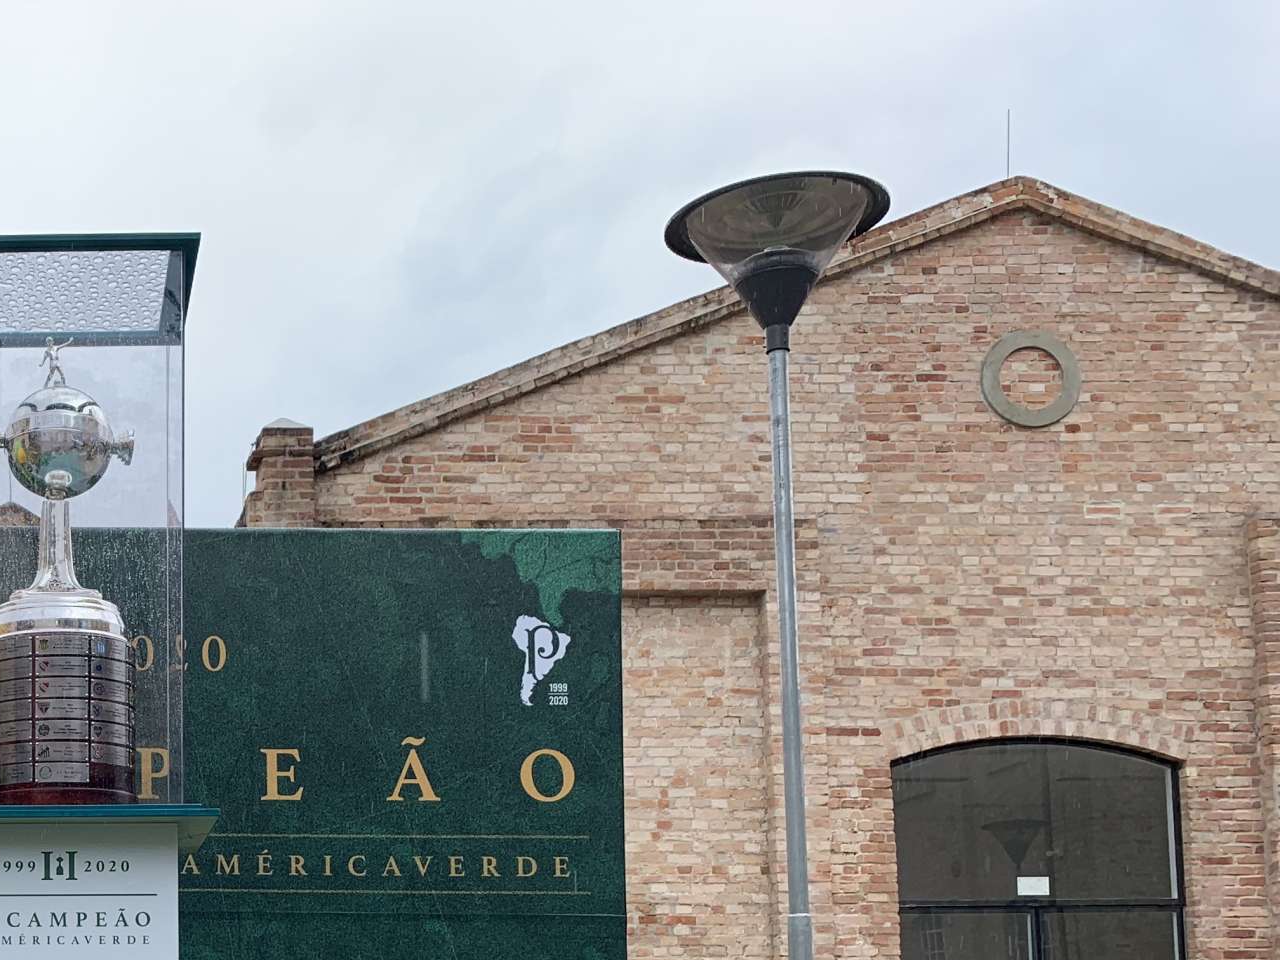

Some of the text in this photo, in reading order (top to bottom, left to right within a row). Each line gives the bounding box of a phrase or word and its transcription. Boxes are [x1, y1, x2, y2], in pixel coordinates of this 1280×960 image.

[549, 683, 568, 693] 1999
[549, 696, 568, 706] 2020
[84, 860, 130, 873] 2020
